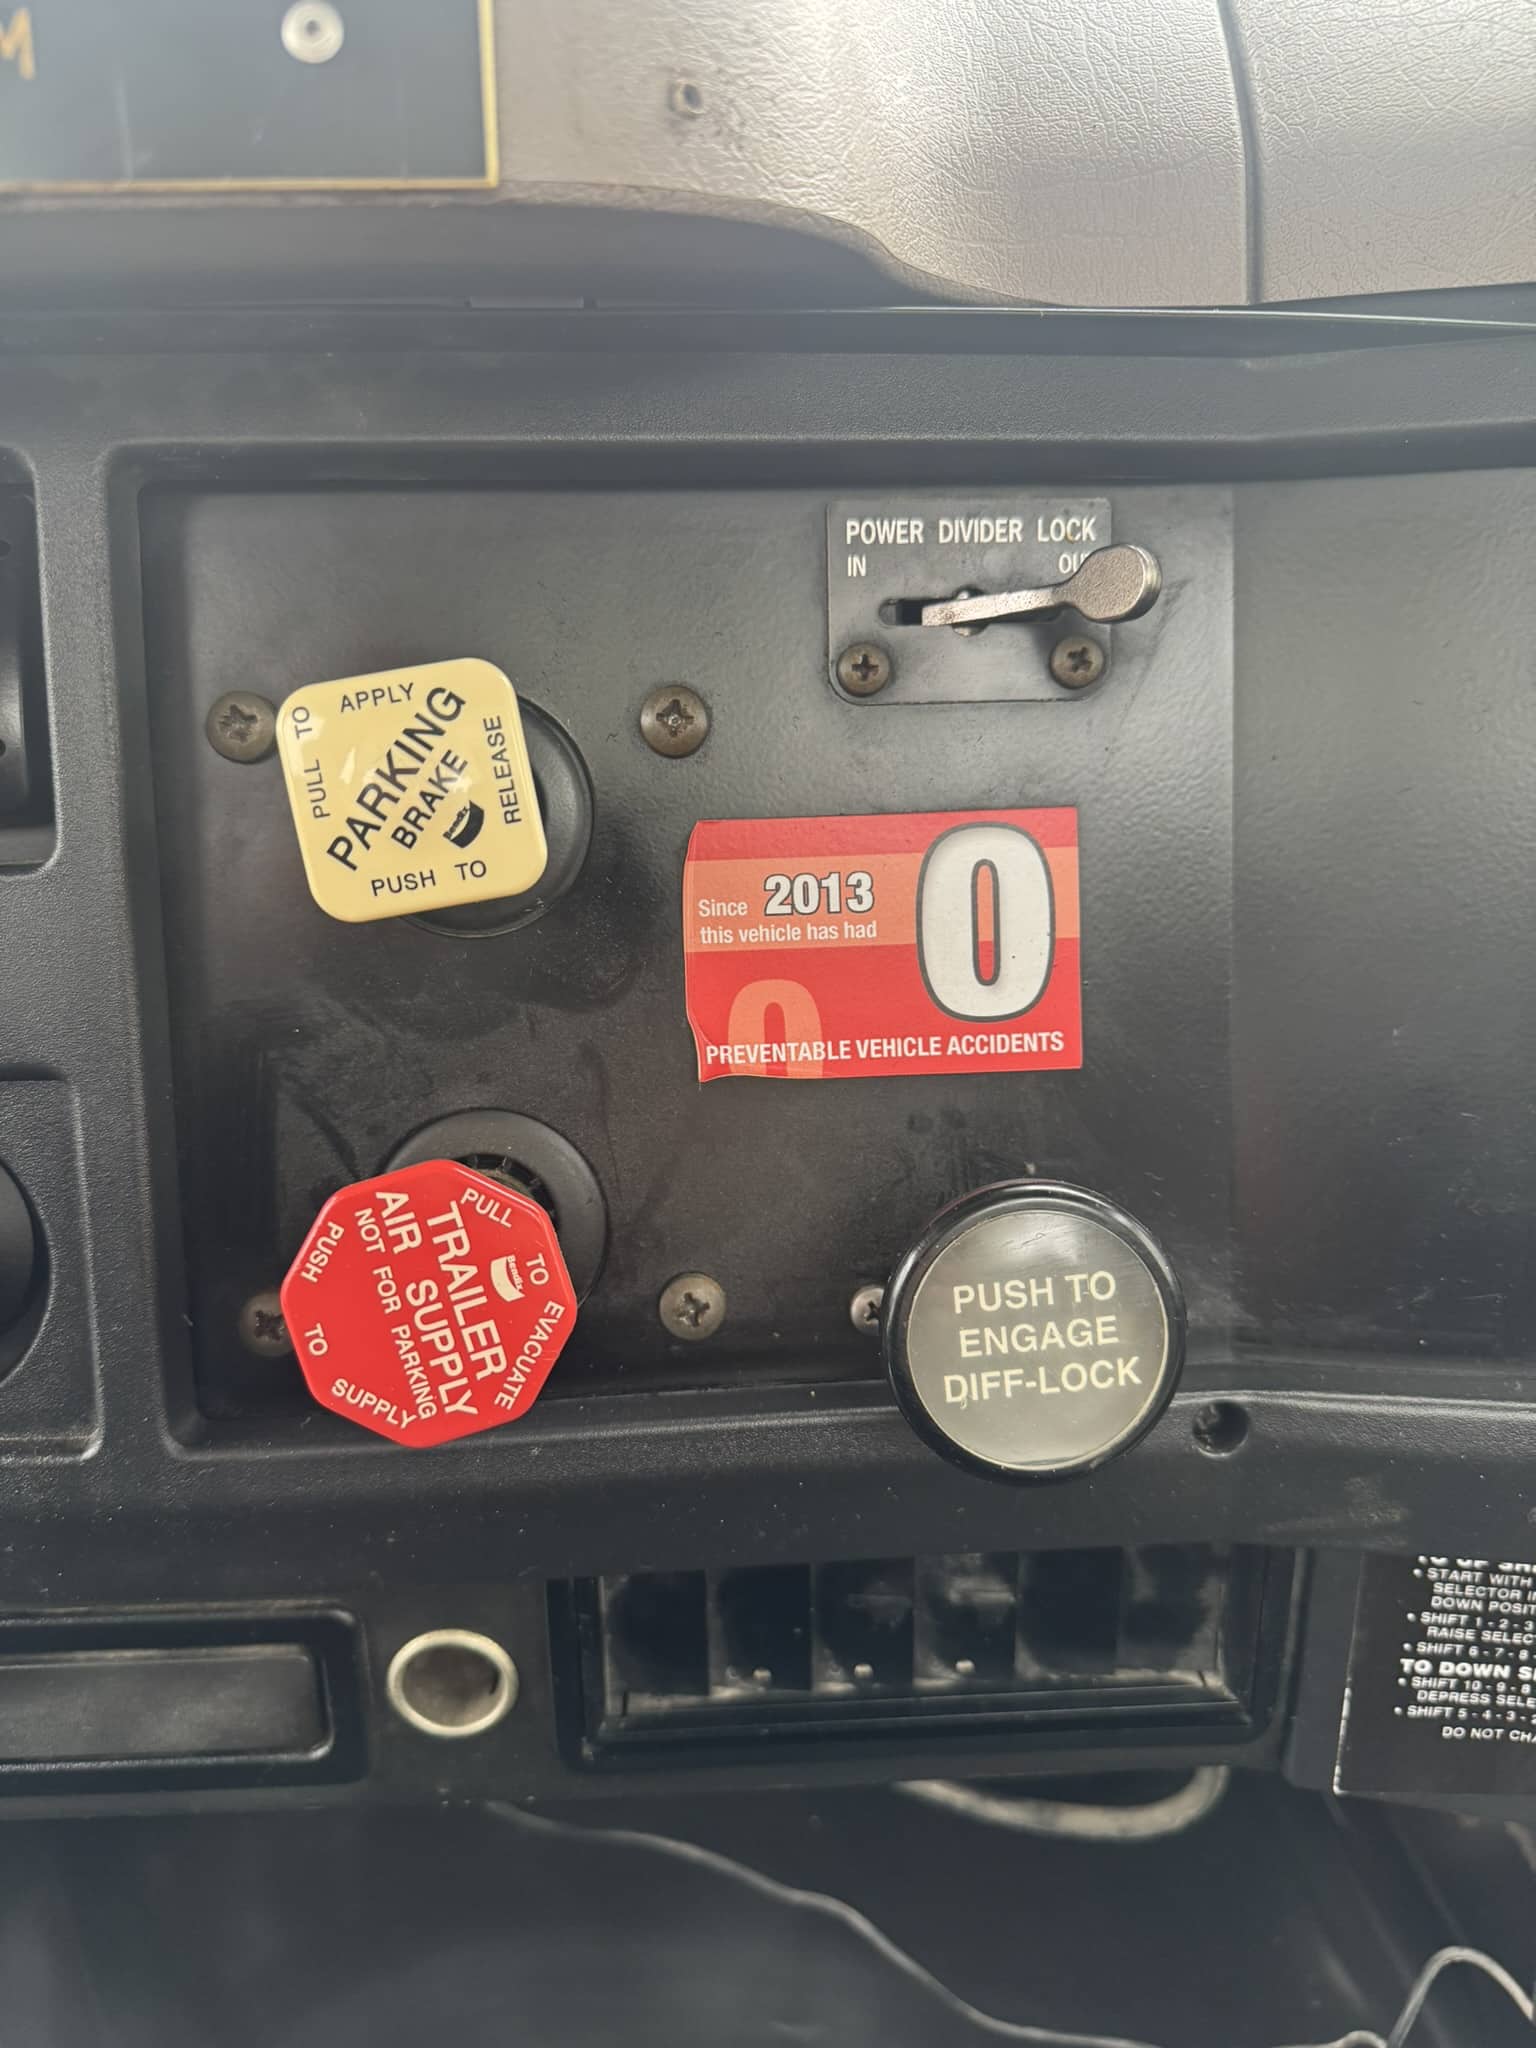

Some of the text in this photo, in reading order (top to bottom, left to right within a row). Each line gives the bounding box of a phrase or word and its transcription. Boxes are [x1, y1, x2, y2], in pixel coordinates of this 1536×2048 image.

[846, 518, 1097, 545] POWER DIVIDER LOCK
[847, 554, 866, 577] IN
[1059, 553, 1090, 574] OU
[292, 682, 414, 819] PULL TO APPLY
[326, 687, 466, 871] PARKING
[371, 715, 522, 897] PUSH TO RELEASE
[391, 749, 468, 850] BRAKE
[698, 871, 874, 918] Since 2013
[700, 920, 877, 944] this vehicle has had
[916, 821, 1056, 1023] 0
[706, 1031, 1064, 1065] PREVENTABLE VEHICLE ACCIDENTS
[375, 1191, 479, 1416] AIR SUPPLY
[427, 1200, 507, 1381] TRAILER
[460, 1188, 566, 1411] PULL TO EVACUATE
[953, 1270, 1116, 1314] PUSH TO
[301, 1221, 417, 1429] PUSH TO SUPPLY
[354, 1207, 437, 1420] NOT FOR PARKING
[959, 1315, 1120, 1358] ENGAGE
[943, 1356, 1142, 1403] DIFF-LOCK
[1427, 1567, 1532, 1588] START WITH
[1433, 1582, 1522, 1600] SELECTOR
[1431, 1595, 1483, 1611] DOWN
[1420, 1611, 1469, 1626] SHIFT
[1498, 1618, 1509, 1630] 2
[1523, 1620, 1533, 1632] 3
[1426, 1626, 1536, 1645] RAISE SELEC
[1416, 1641, 1464, 1656] SHIFT
[1494, 1647, 1505, 1658] 7
[1400, 1657, 1536, 1682] TO DOWN S
[1411, 1676, 1459, 1689] SHIFT
[1407, 1705, 1454, 1718] SHIFT
[1416, 1689, 1491, 1705] DEPRESS
[1442, 1726, 1466, 1739] DO
[1470, 1727, 1504, 1739] NOT
